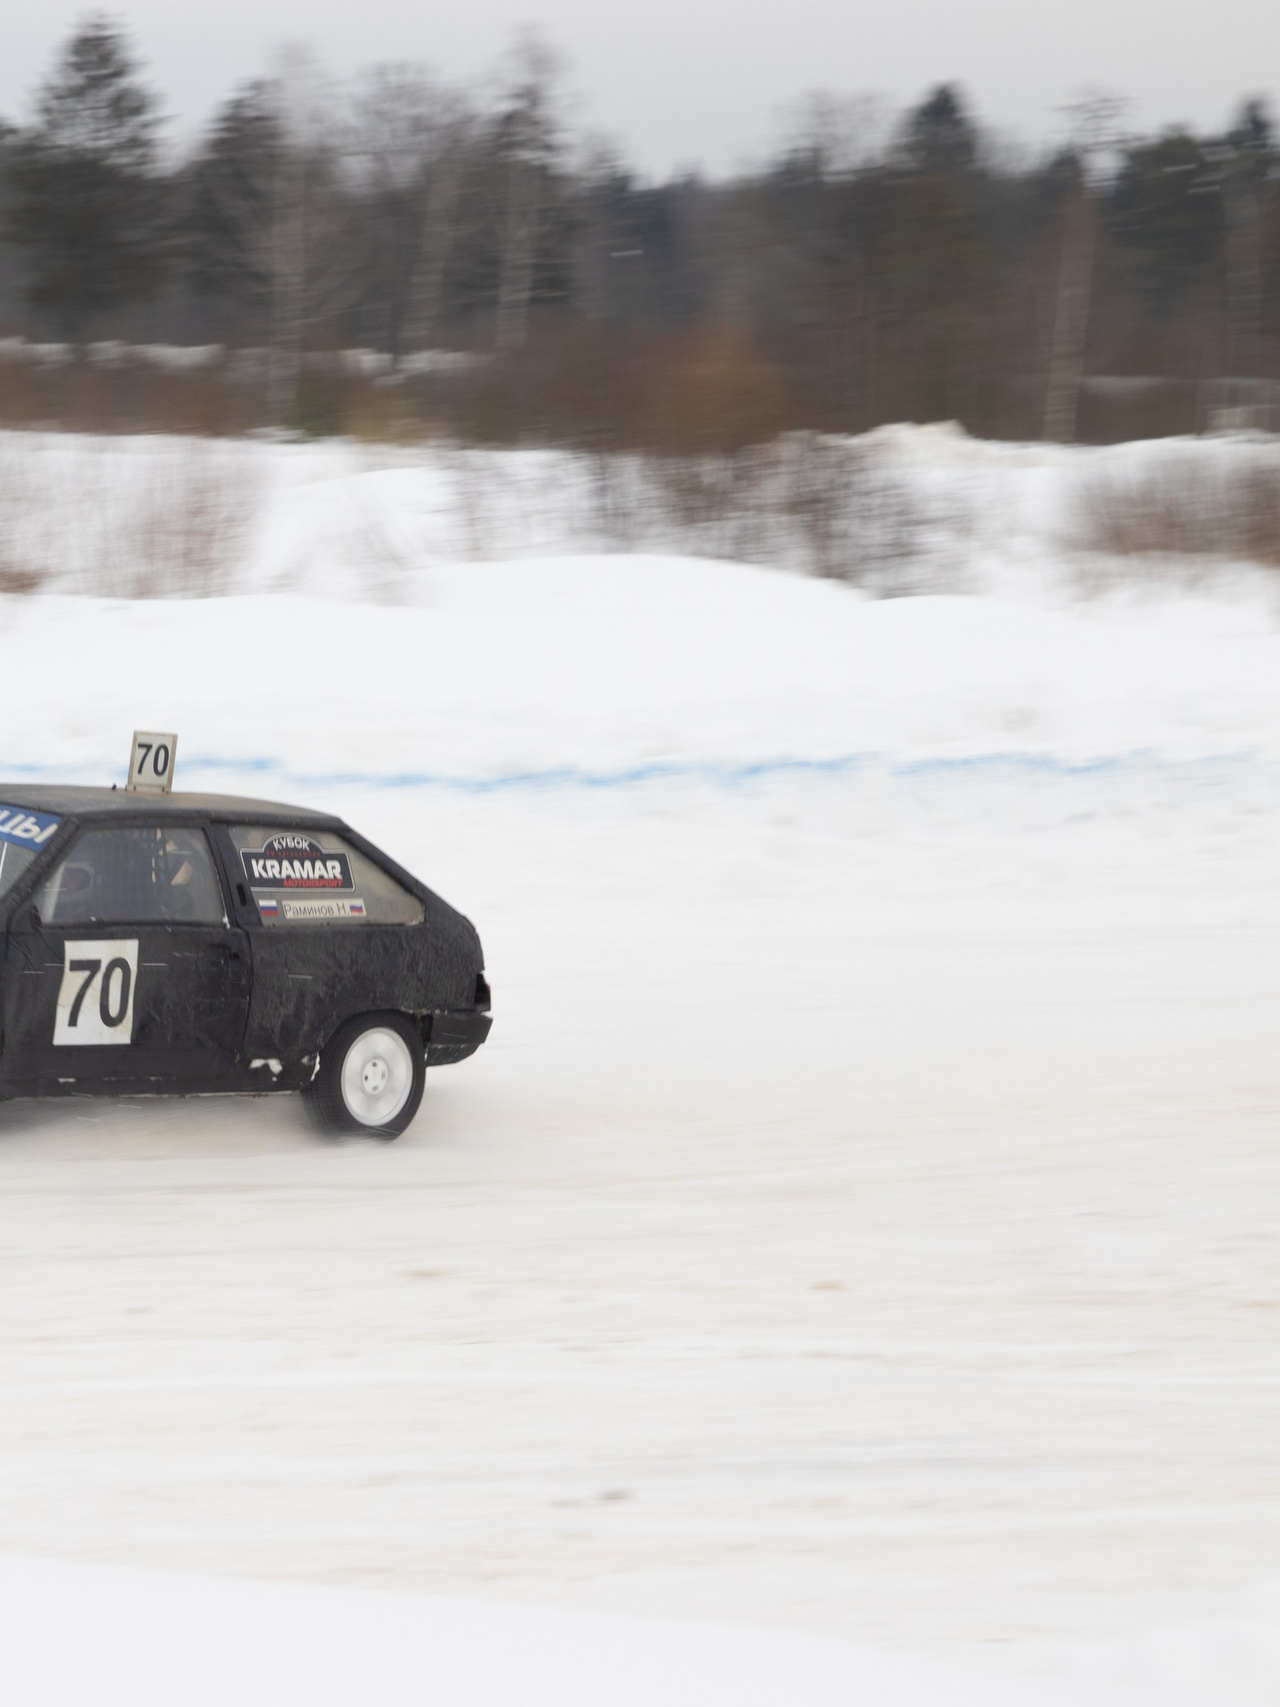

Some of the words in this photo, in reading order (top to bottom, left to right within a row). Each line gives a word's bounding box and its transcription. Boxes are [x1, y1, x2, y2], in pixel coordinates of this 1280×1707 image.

[136, 743, 170, 776] 70
[272, 835, 310, 851] КУБОК
[250, 858, 343, 879] KRAMAR
[282, 878, 343, 887] MOTORSPORT
[283, 902, 335, 917] Раминов
[67, 957, 132, 1028] 70
